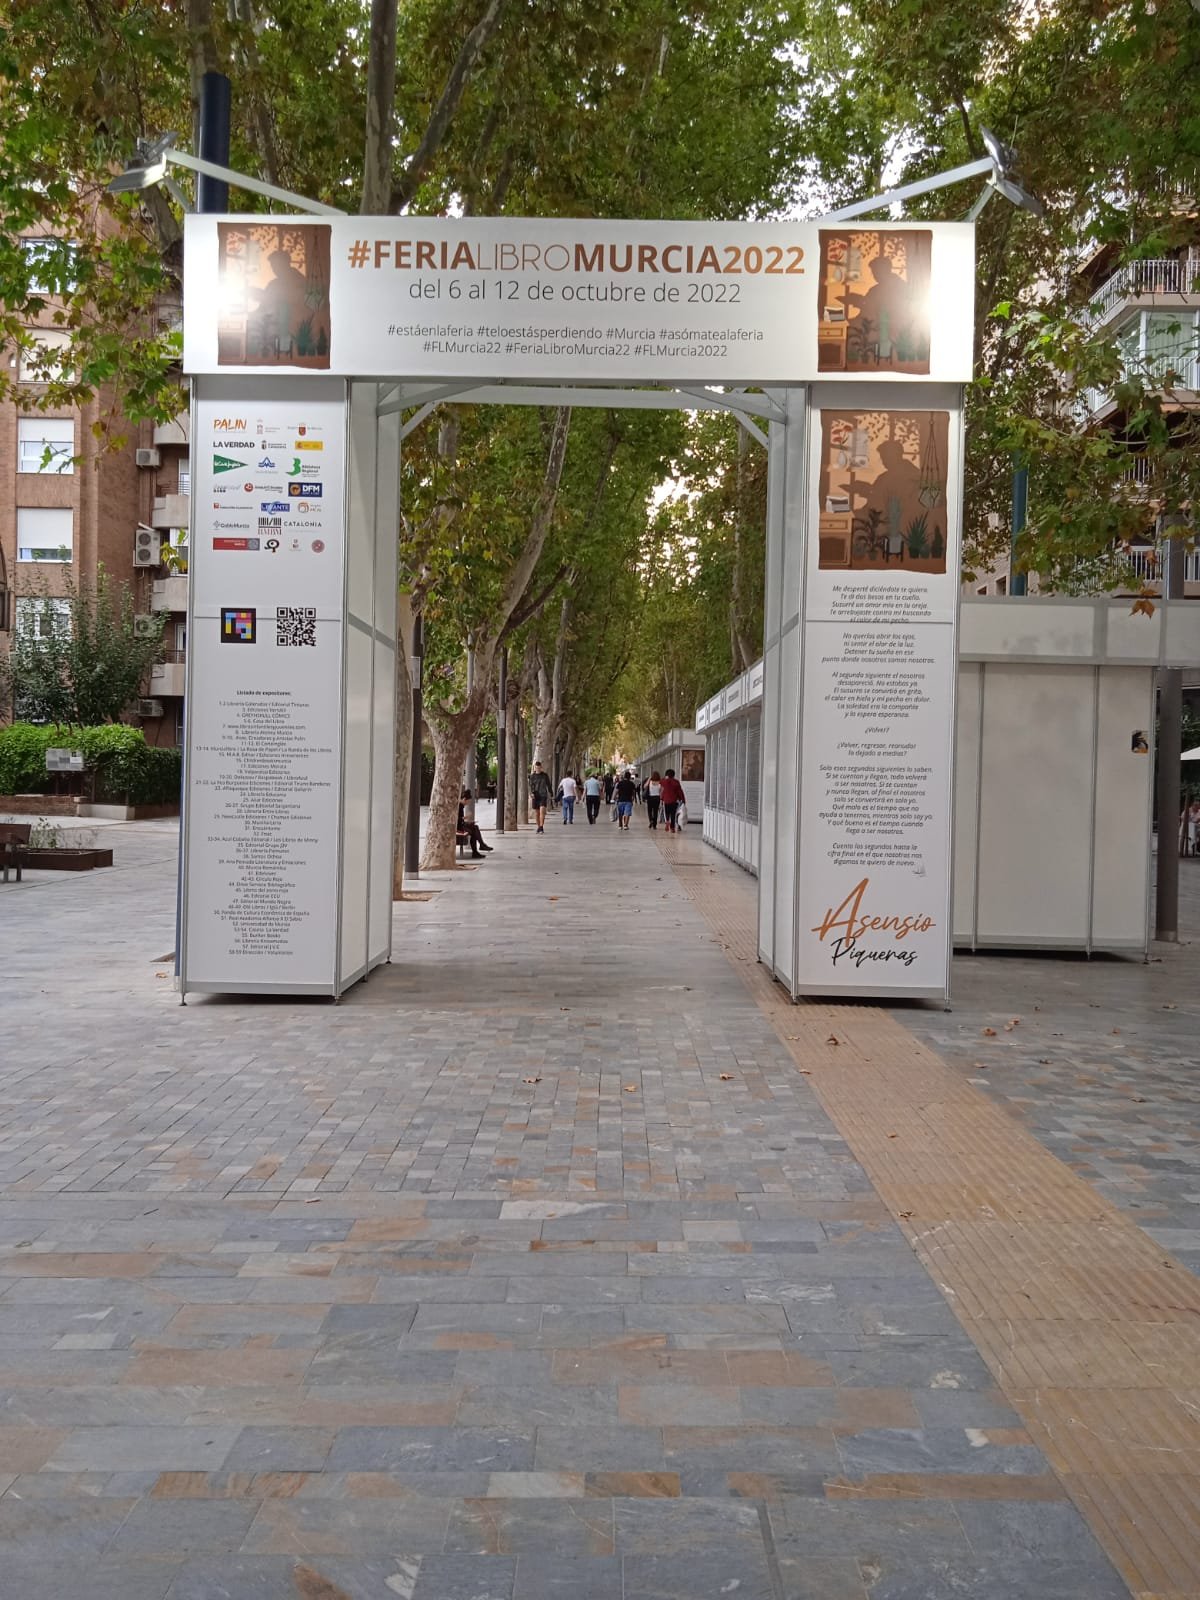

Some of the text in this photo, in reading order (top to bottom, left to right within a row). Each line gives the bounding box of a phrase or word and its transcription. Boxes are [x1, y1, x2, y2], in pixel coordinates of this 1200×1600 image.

[348, 240, 804, 273] #FERIALIBROMURCIA2022
[410, 278, 740, 302] del 6 al 12 de octubre de 2022
[389, 325, 763, 342] #estáenlaferia #teloestásperdiendo #Murcia #asómatealaferia
[424, 341, 726, 356] #FLMurcia22 #FeriaLibroMurcia22 #FLMurcia2022
[811, 878, 936, 948] Asensio
[831, 936, 918, 968] Piqueras
